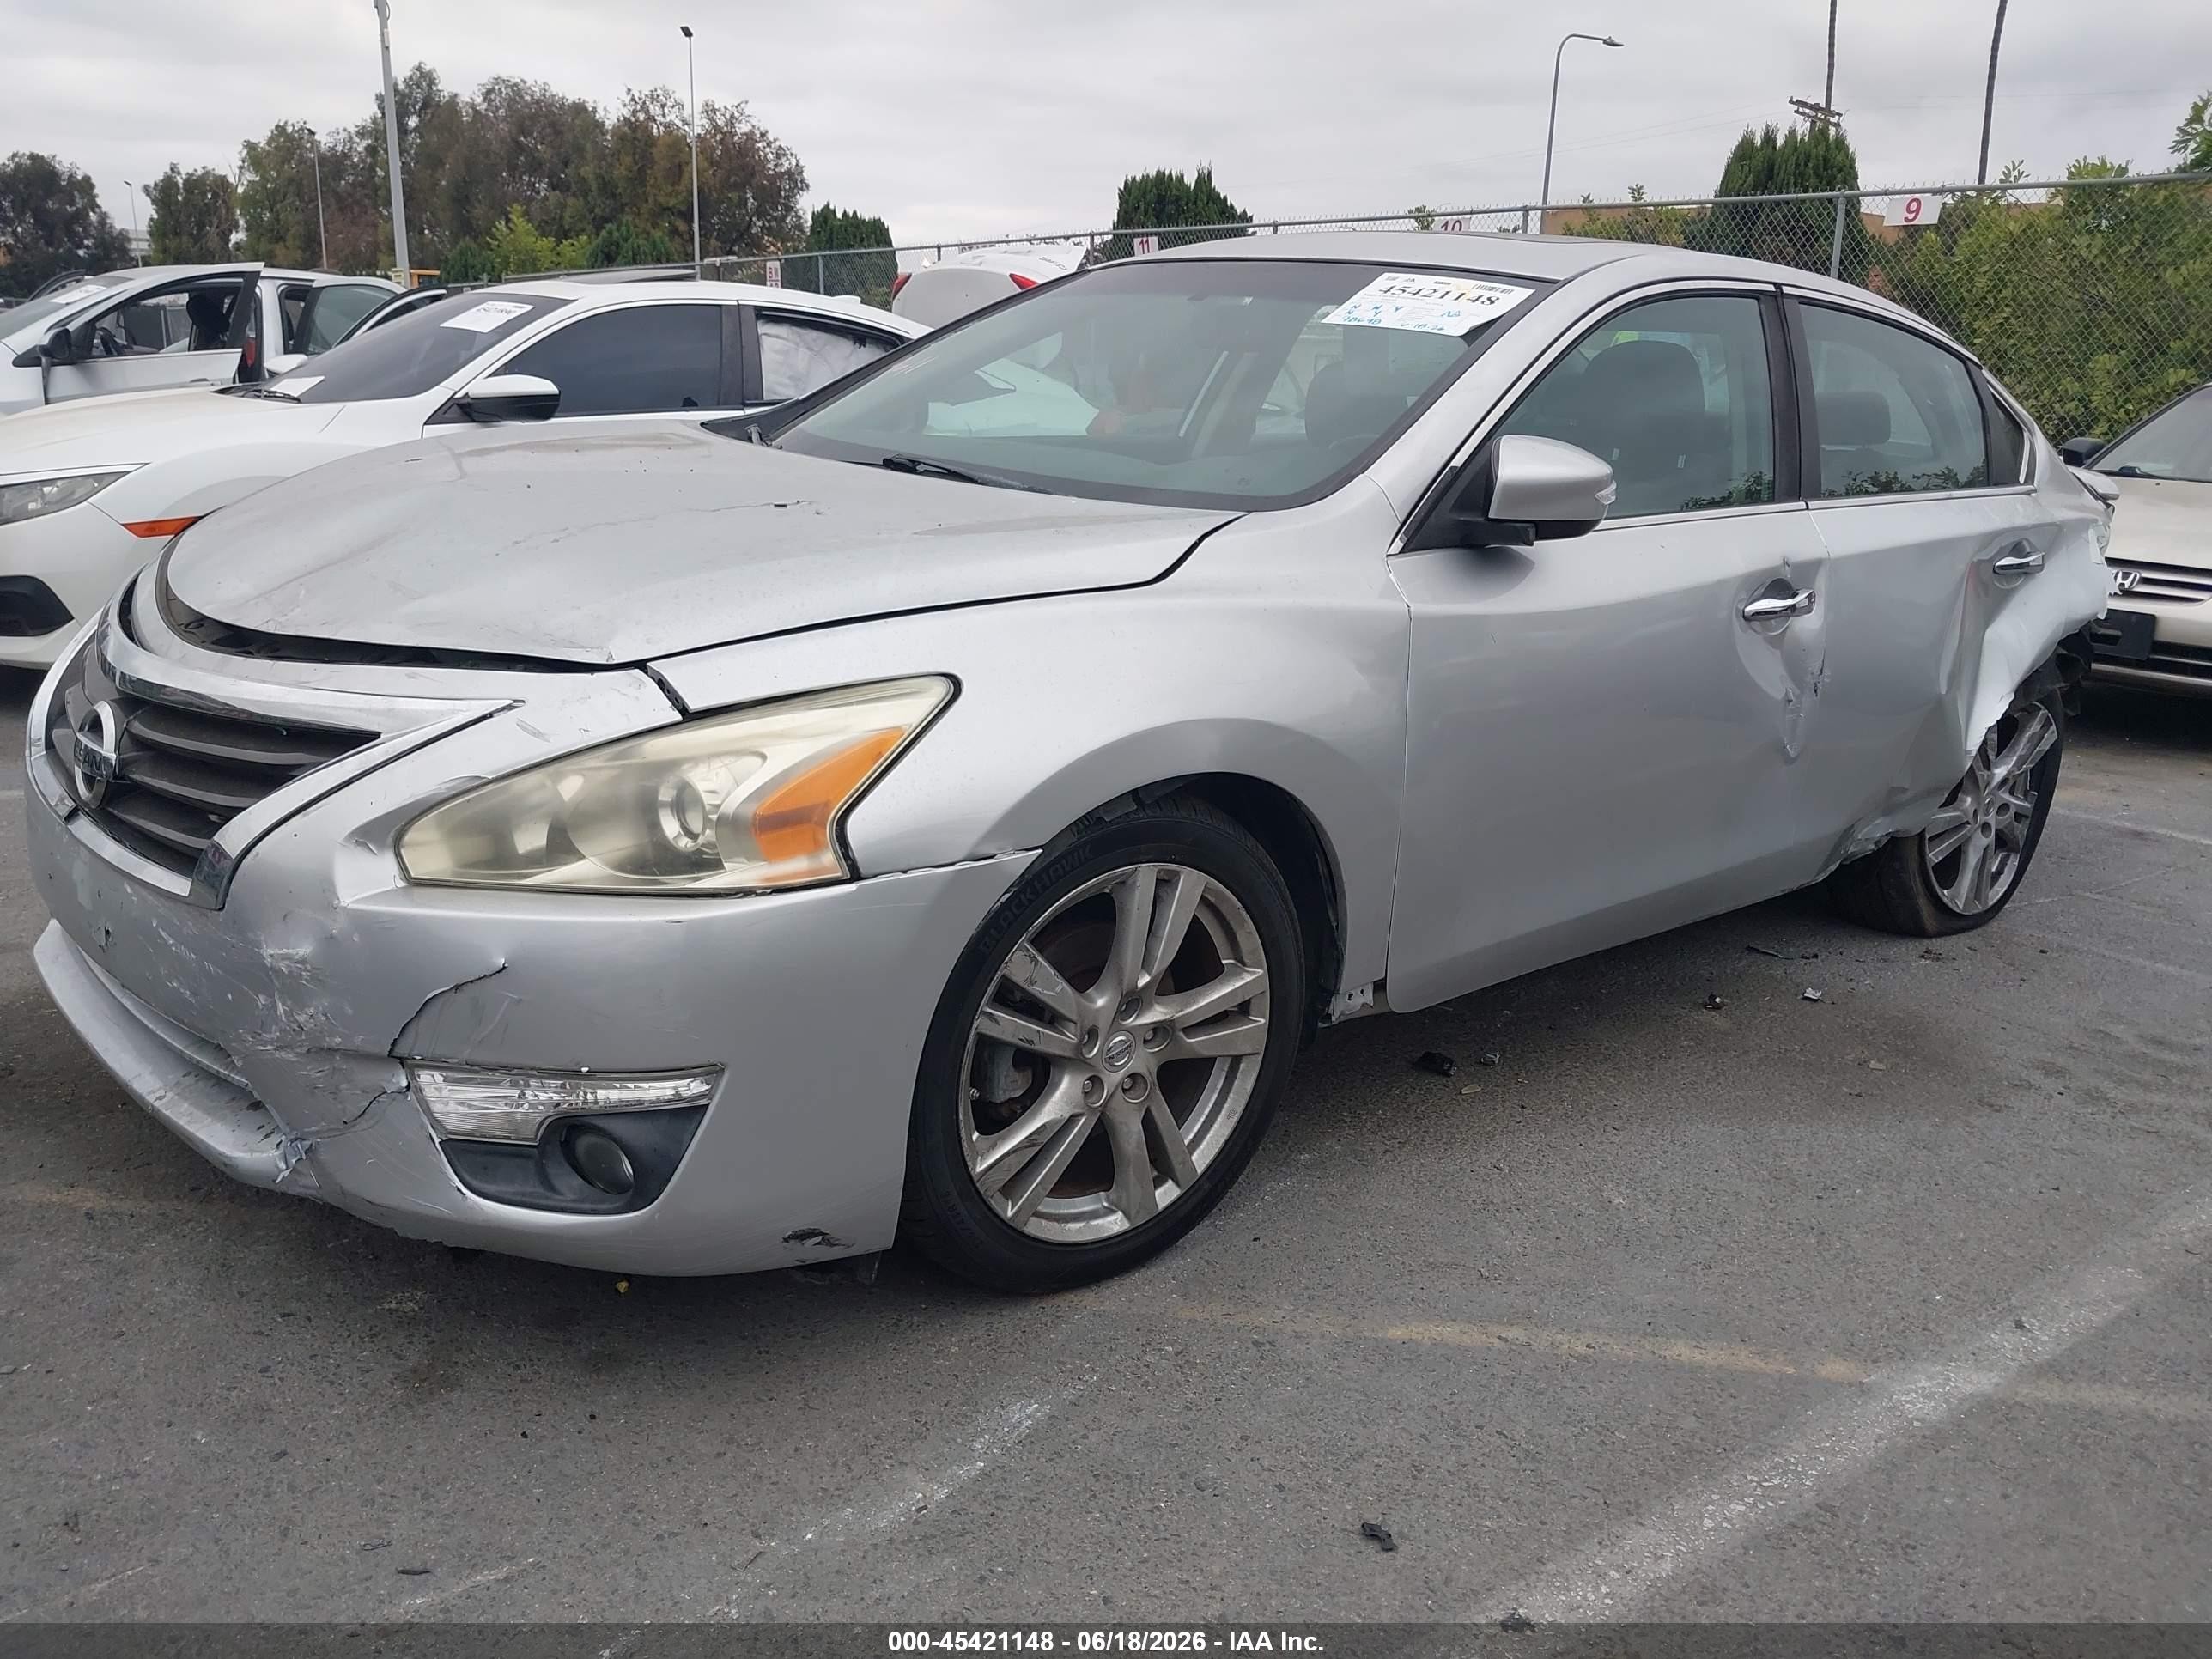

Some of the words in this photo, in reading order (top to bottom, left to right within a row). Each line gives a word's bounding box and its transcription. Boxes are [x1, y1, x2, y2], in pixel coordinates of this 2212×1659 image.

[1904, 198, 1922, 223] 9
[1139, 238, 1151, 255] 11
[1377, 284, 1501, 306] 45421148
